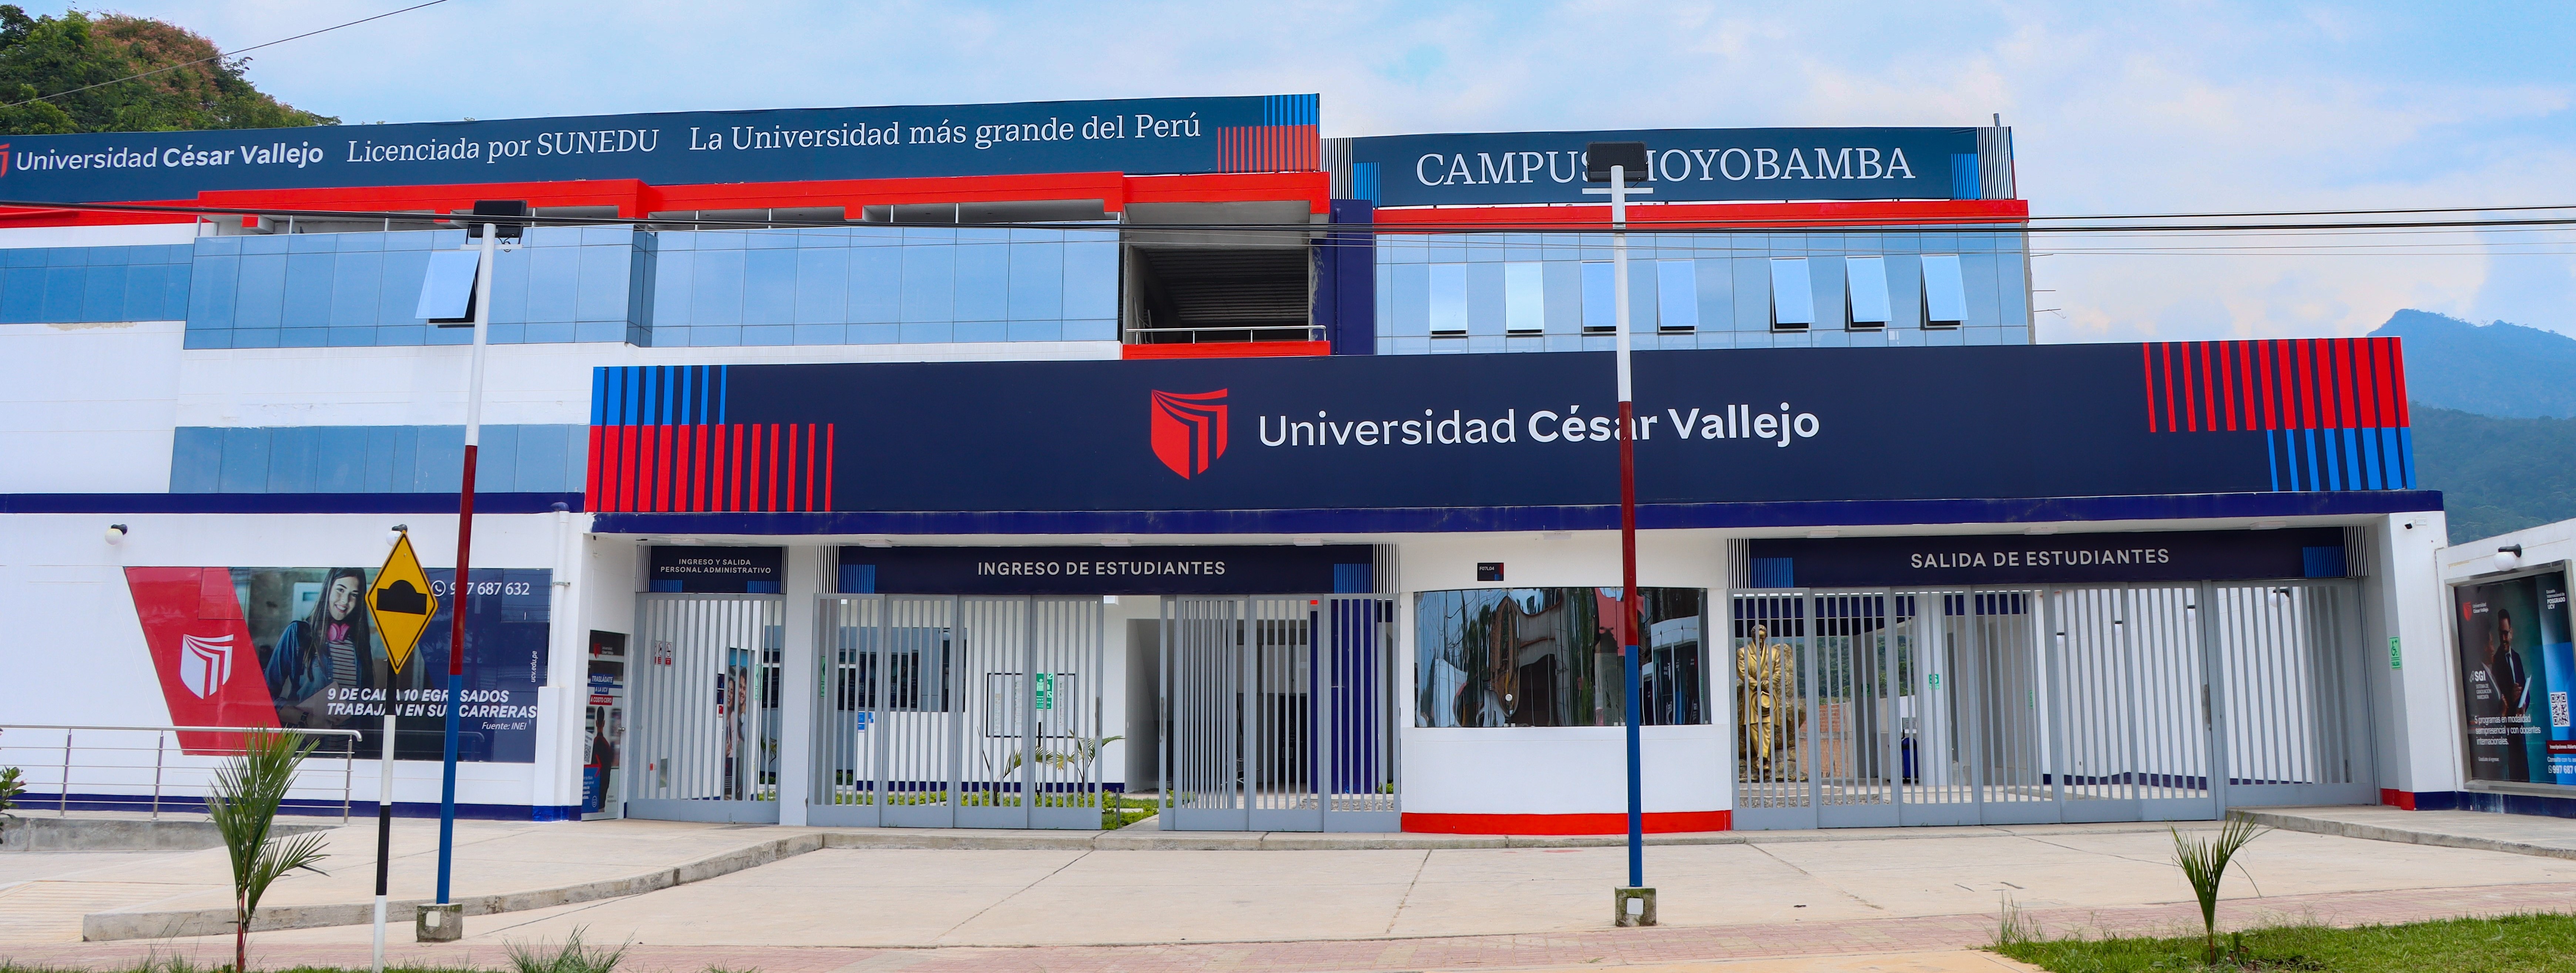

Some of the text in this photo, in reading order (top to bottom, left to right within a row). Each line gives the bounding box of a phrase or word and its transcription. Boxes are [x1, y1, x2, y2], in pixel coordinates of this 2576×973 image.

[689, 112, 1201, 151] La Universidad más grande del Perú
[346, 129, 660, 164] Licenciada por SUNEDU
[16, 141, 324, 171] Universidad César Vallejo
[1259, 408, 1515, 446] Universidad
[1667, 404, 1820, 447] Vallejo
[1911, 548, 2169, 568] SALIDA DE ESTUDIANTES
[978, 561, 1226, 575] INGRESO DE ESTUDIANTES
[450, 582, 530, 595] 97 687 632
[530, 651, 539, 683] ucv.edu.pe
[2475, 670, 2486, 681] SGI
[328, 688, 336, 700] 9
[339, 688, 358, 701] DE
[404, 689, 419, 701] 10
[421, 689, 509, 703] EGRSADOS
[405, 704, 425, 717] EN
[427, 704, 448, 717] SU
[459, 705, 537, 719] CARRERAS
[482, 722, 510, 730] Fuente:
[2474, 715, 2478, 724] 5
[2478, 716, 2500, 725] programas
[2508, 714, 2531, 723] modalidad
[2520, 725, 2541, 734] docentes
[2552, 765, 2562, 774] 997
[2563, 765, 2573, 774] 687
